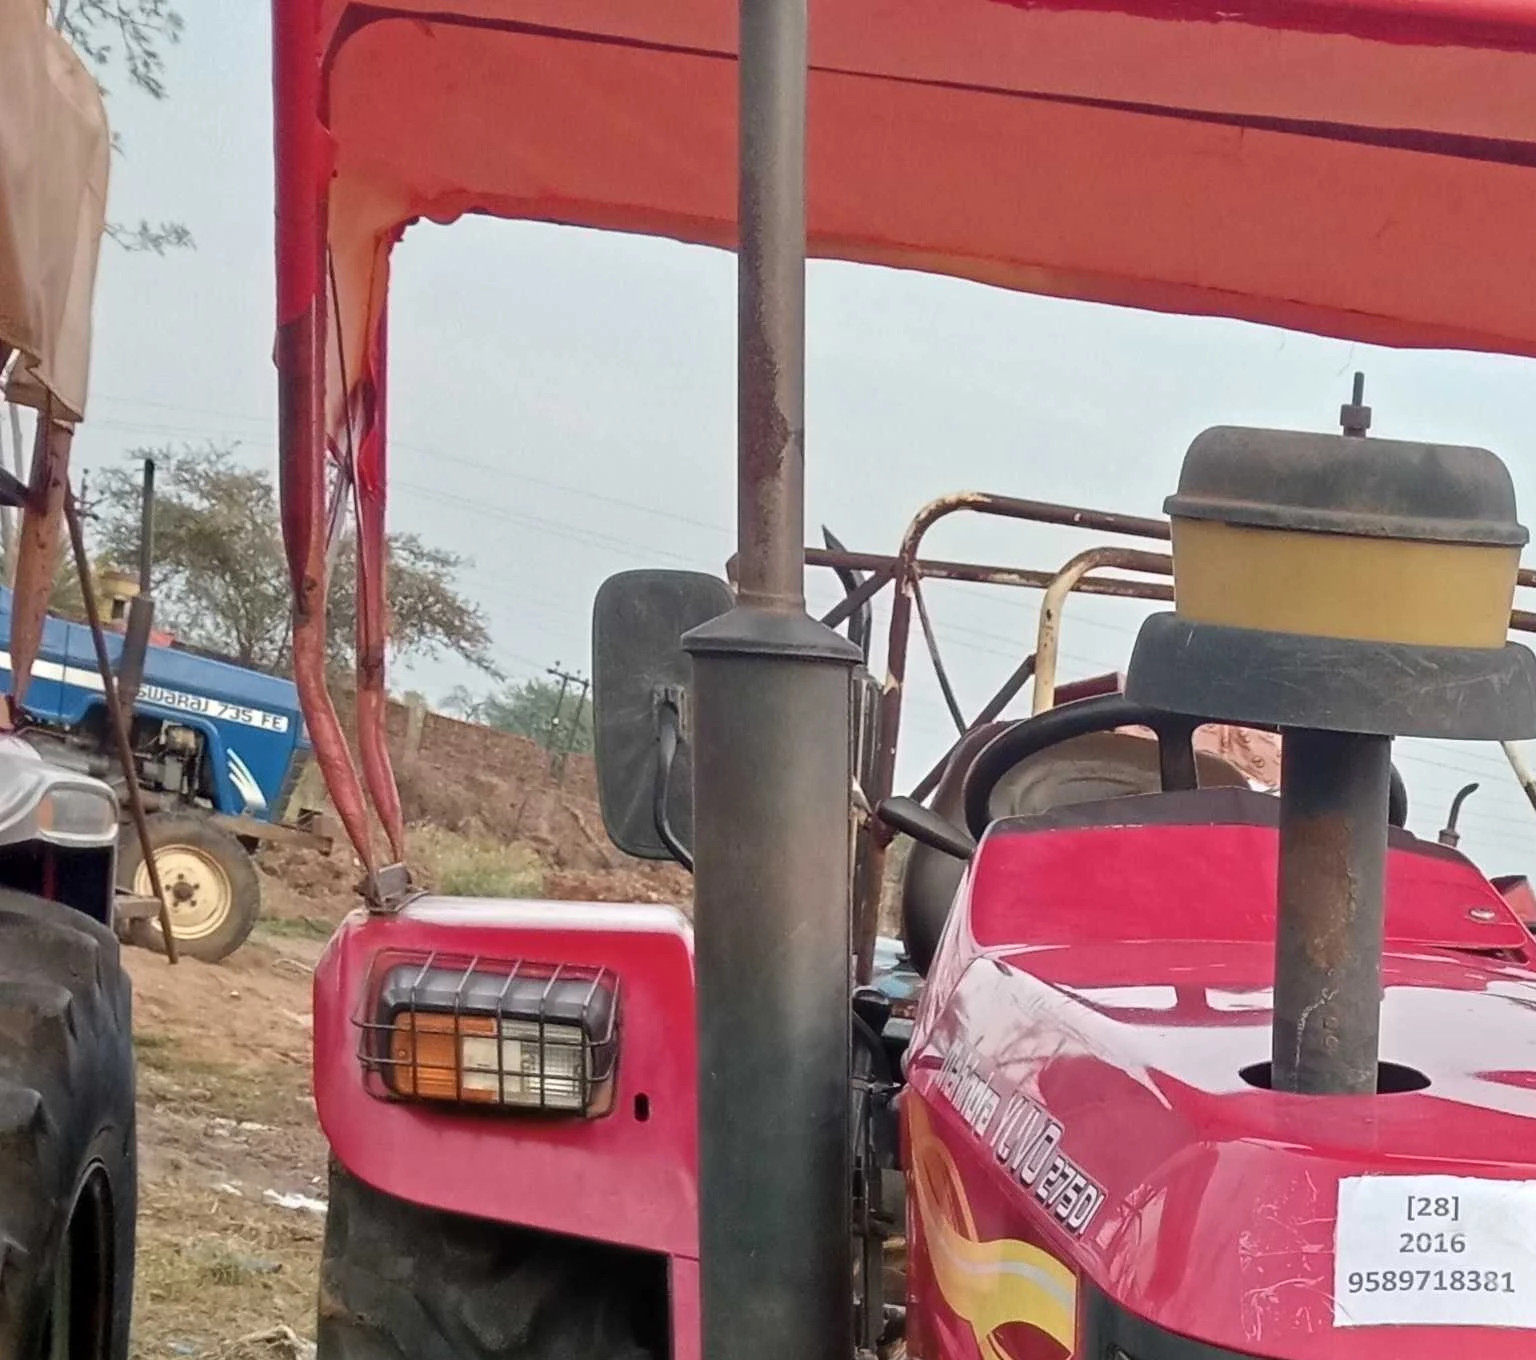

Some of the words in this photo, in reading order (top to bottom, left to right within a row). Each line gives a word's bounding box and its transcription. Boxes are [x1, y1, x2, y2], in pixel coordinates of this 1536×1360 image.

[216, 703, 253, 723] 735
[261, 713, 283, 731] FE
[989, 1090, 1064, 1187] YUVO
[1034, 1153, 1106, 1237] 275DI
[1406, 1195, 1460, 1221] [28]
[1399, 1232, 1466, 1253] 2016
[1347, 1270, 1516, 1293] 9589718381
